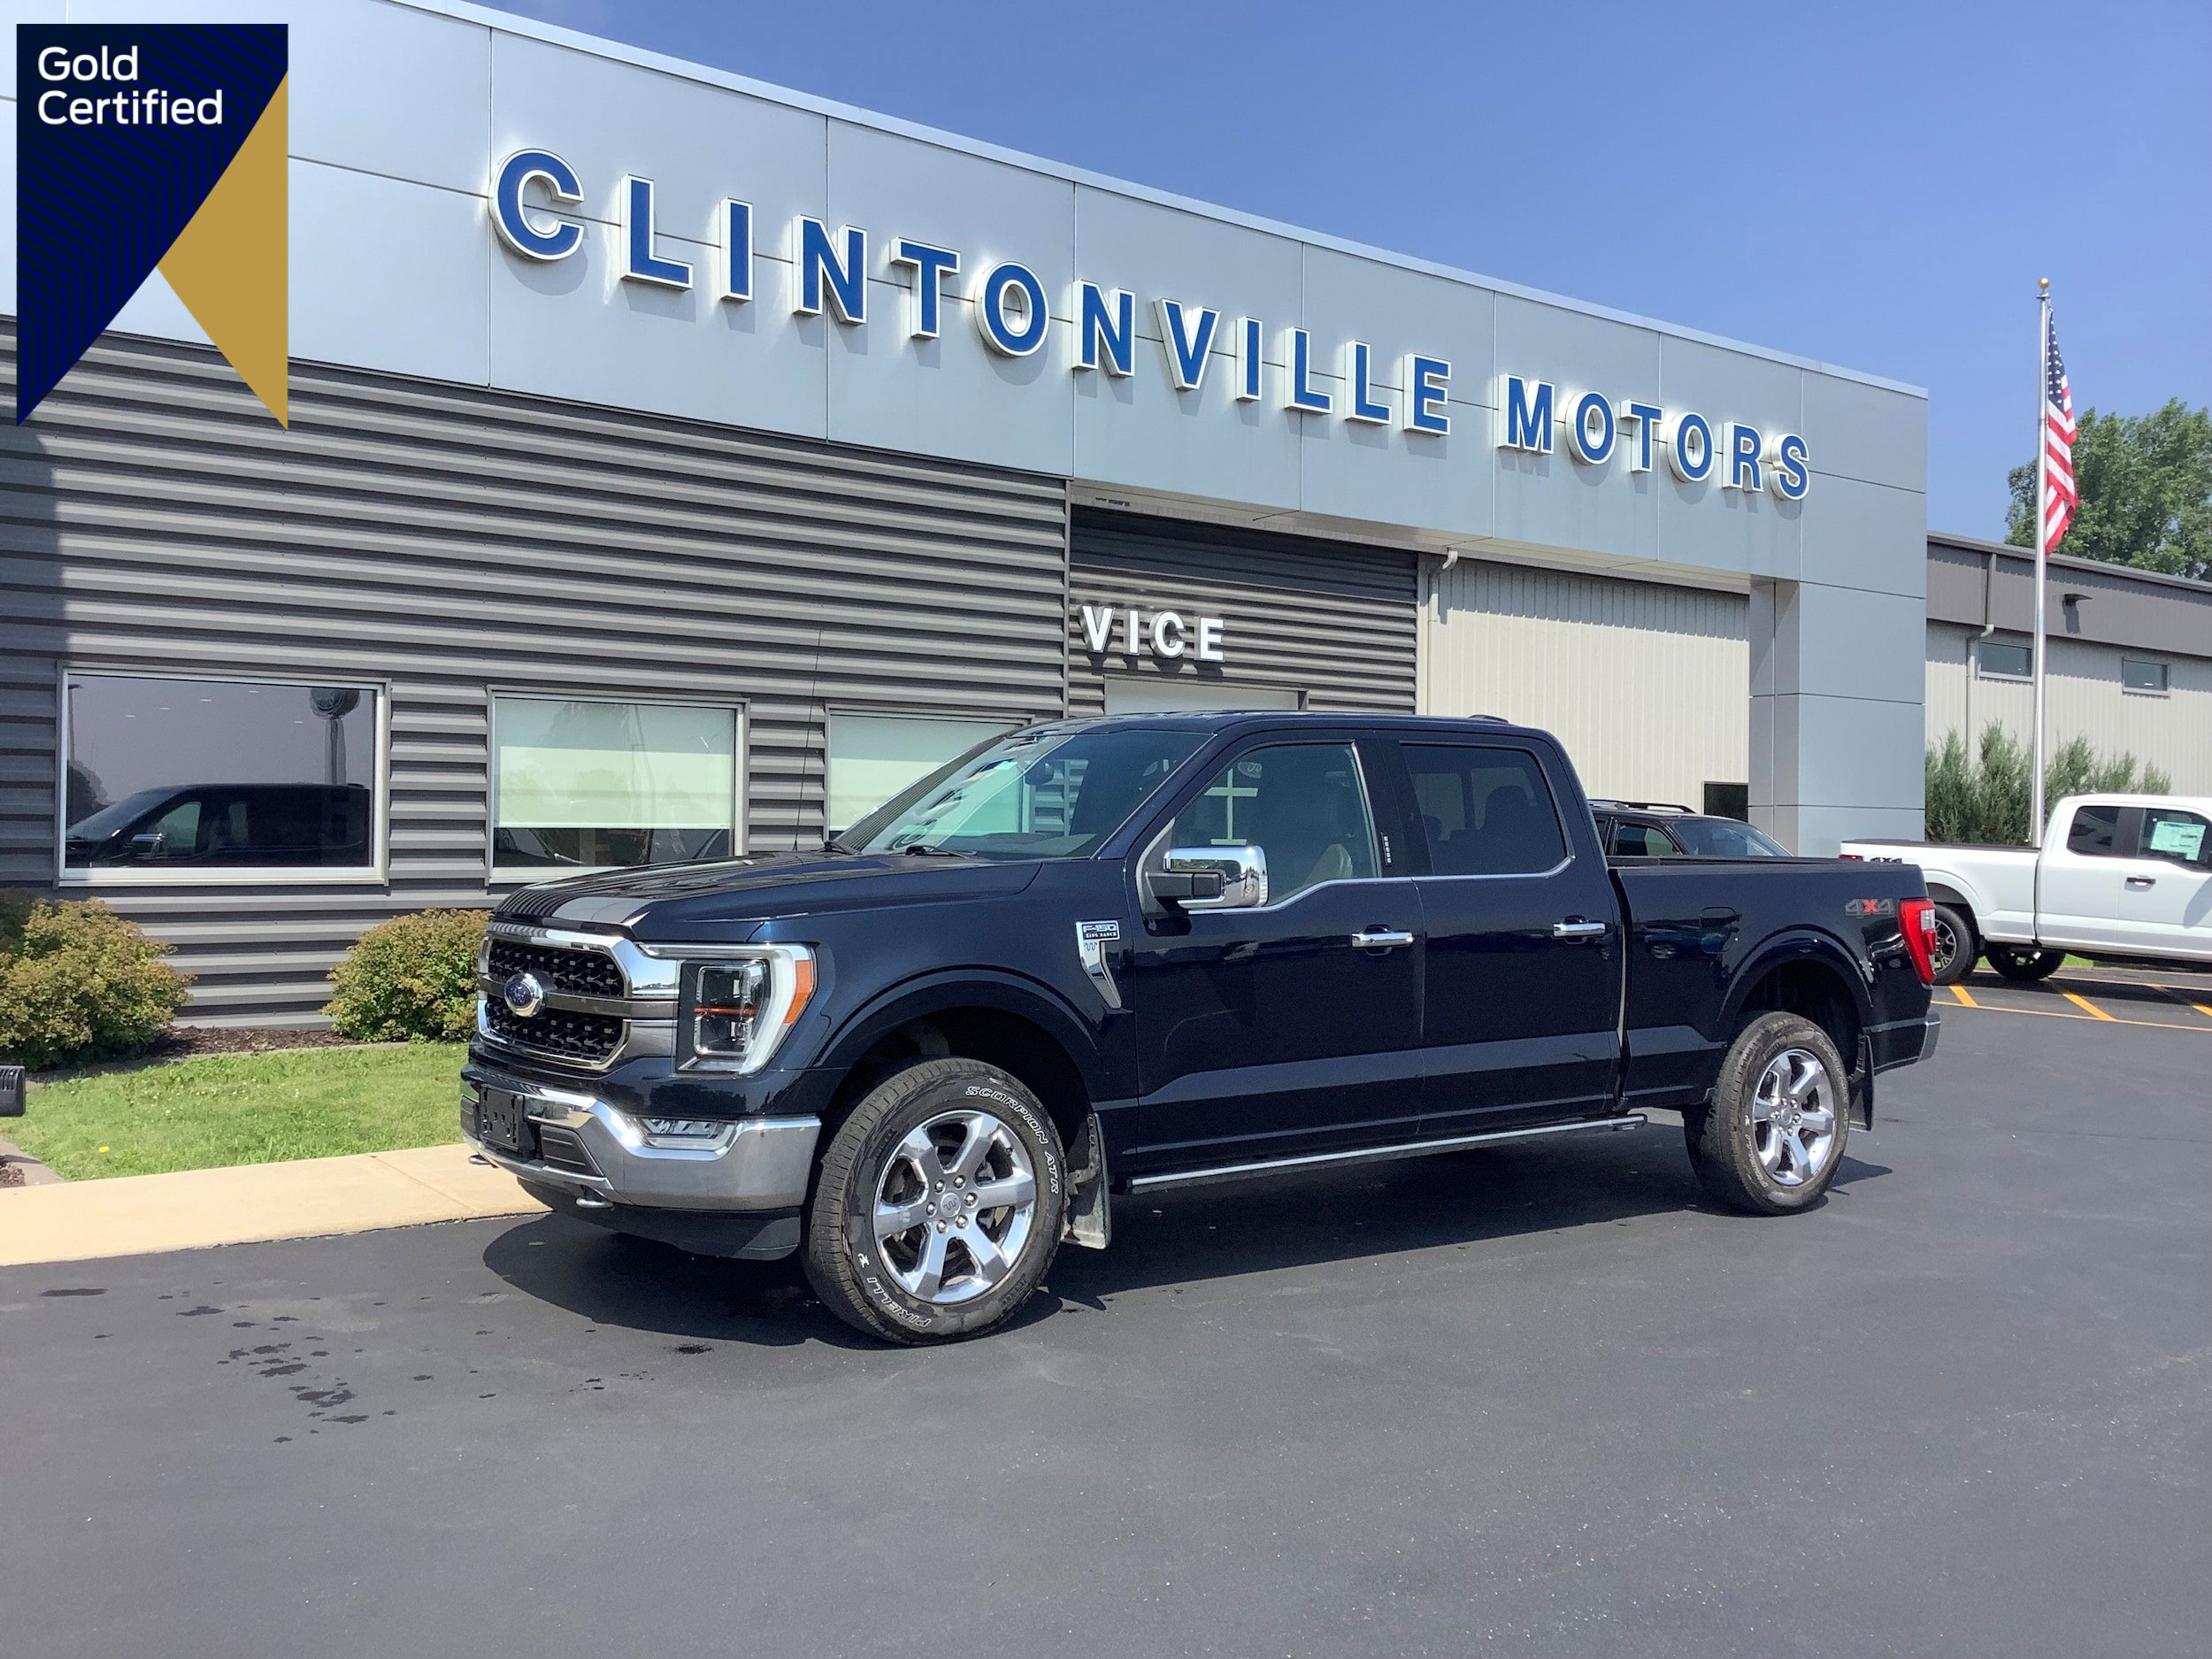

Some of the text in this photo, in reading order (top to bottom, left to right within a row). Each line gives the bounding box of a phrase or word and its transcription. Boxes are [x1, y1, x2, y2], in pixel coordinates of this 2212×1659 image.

[489, 148, 1810, 502] CLINTONVILLE MOTORS
[1083, 924, 1118, 933] F-150
[965, 1086, 1059, 1194] SCORPION ATR
[867, 1277, 932, 1327] PIRELLI
